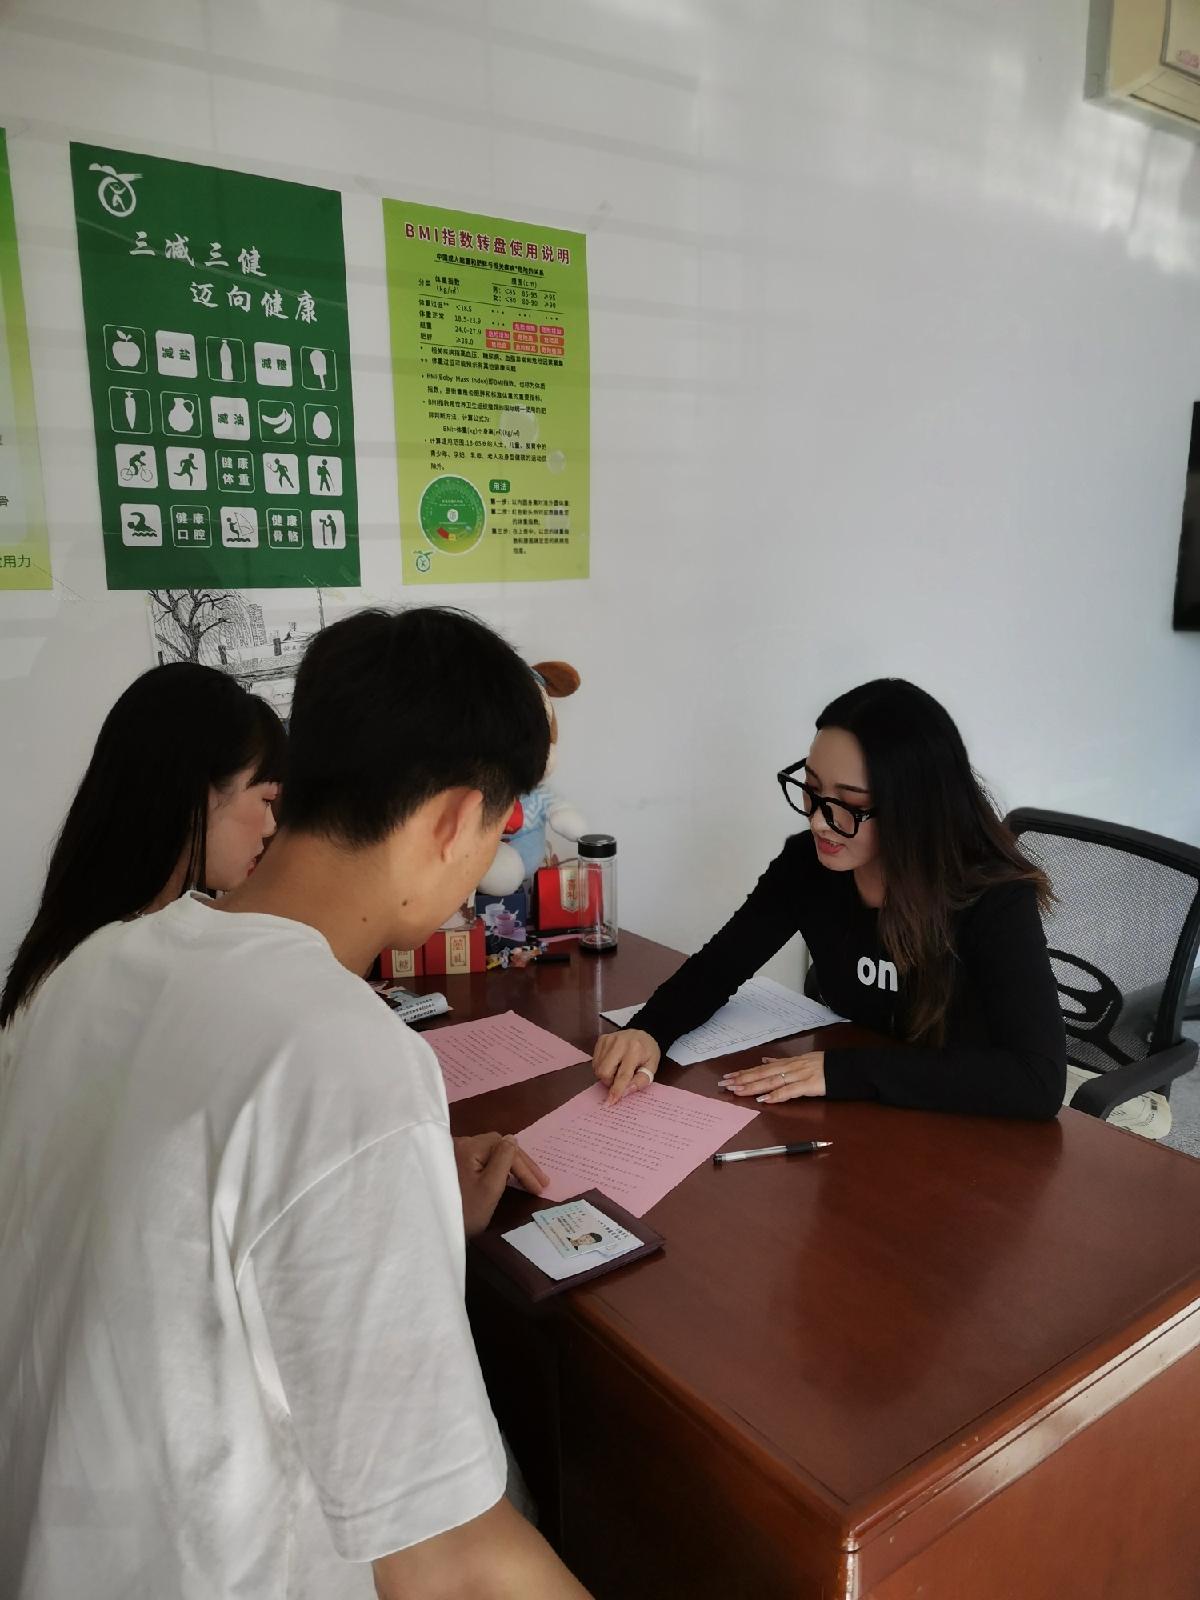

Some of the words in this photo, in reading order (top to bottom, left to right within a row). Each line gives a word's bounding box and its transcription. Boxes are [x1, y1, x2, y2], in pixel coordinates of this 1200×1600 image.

[405, 223, 571, 264] BMI指数转盘使用说明
[129, 231, 266, 277] 三减三健
[189, 282, 318, 324] 迈向健康
[161, 345, 191, 361] 减盐
[261, 357, 288, 371] 减糖
[217, 413, 245, 426] 减油
[221, 456, 249, 469] 健康
[222, 473, 251, 486] 体重
[493, 482, 507, 491] 用法
[175, 512, 205, 525] 健康
[271, 514, 298, 526] 健康
[177, 529, 206, 541] 口腔
[272, 530, 299, 542] 骨骼
[0, 554, 31, 568] 用力
[857, 956, 898, 992] on
